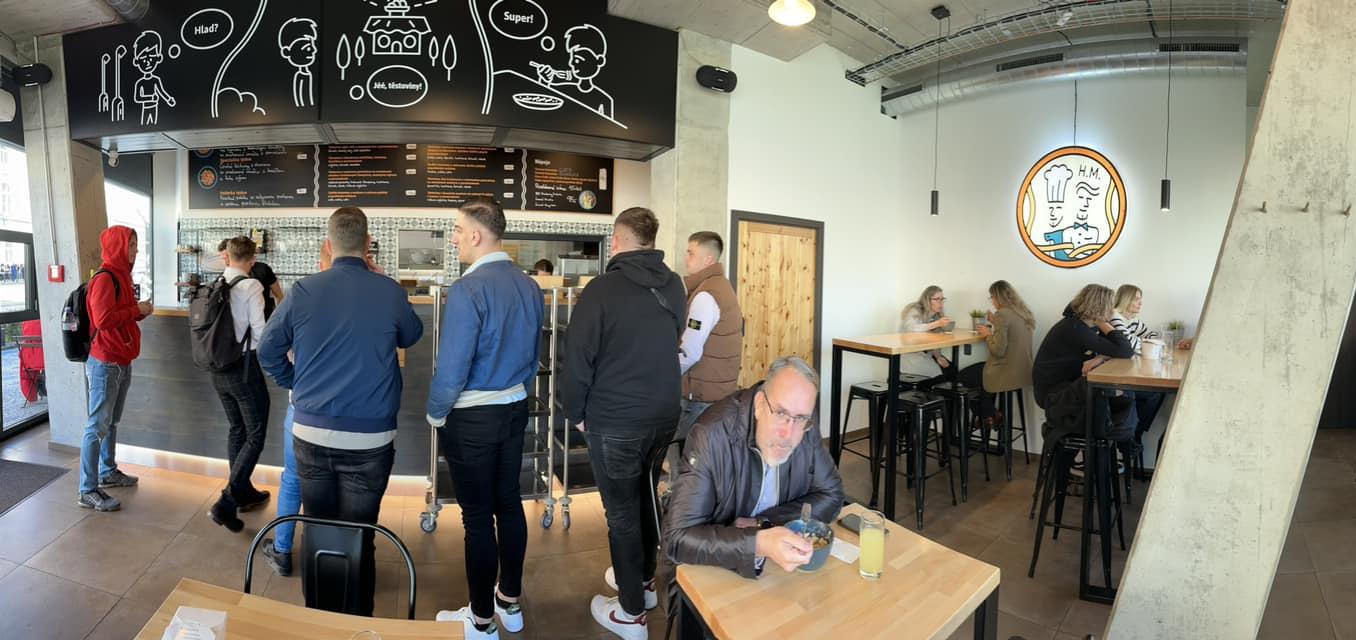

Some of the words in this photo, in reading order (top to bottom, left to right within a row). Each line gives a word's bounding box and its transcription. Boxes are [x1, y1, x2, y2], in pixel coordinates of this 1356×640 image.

[503, 11, 534, 24] Super!
[194, 23, 219, 35] Hlad?
[1078, 164, 1101, 180] H.M.
